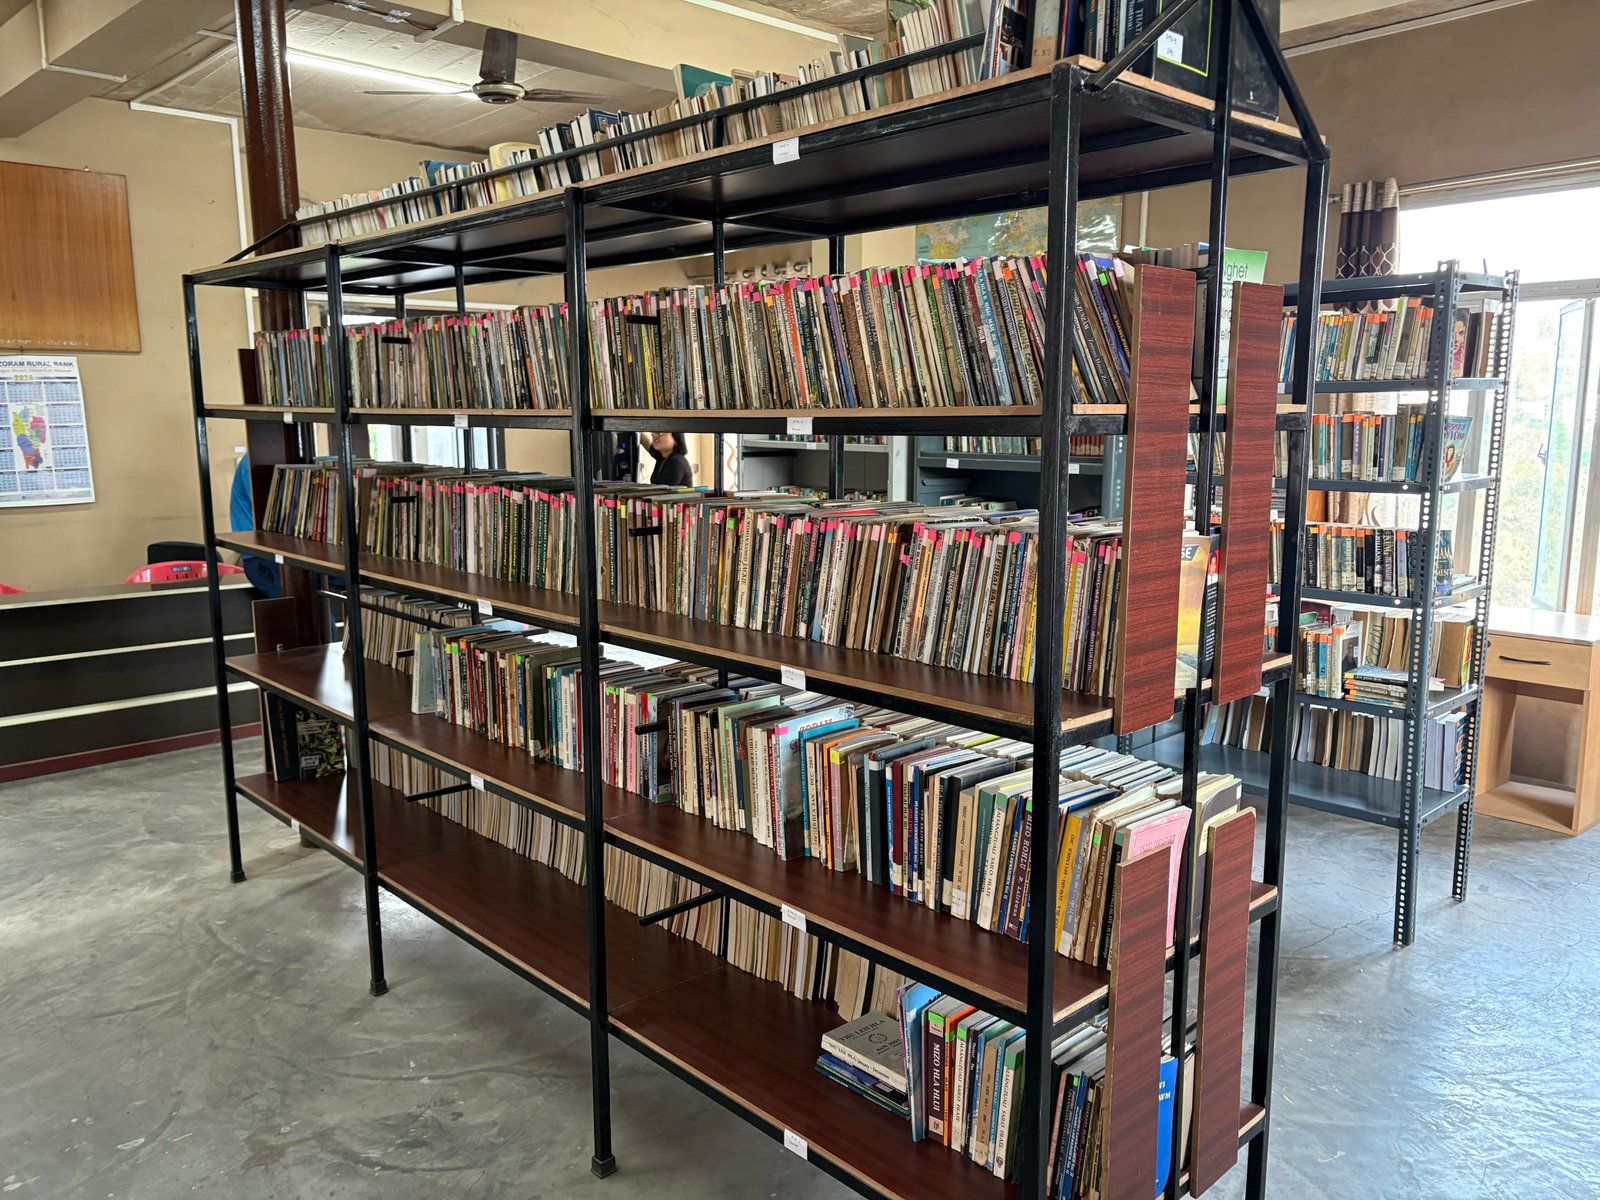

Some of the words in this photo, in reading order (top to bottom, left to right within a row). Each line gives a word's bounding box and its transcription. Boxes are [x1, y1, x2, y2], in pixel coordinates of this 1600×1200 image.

[944, 569, 955, 603] KIDNAPPED
[1024, 814, 1032, 836] MIZO
[1019, 839, 1028, 869] ROHLU
[1062, 847, 1072, 875] DECEMBER
[855, 1059, 870, 1069] January
